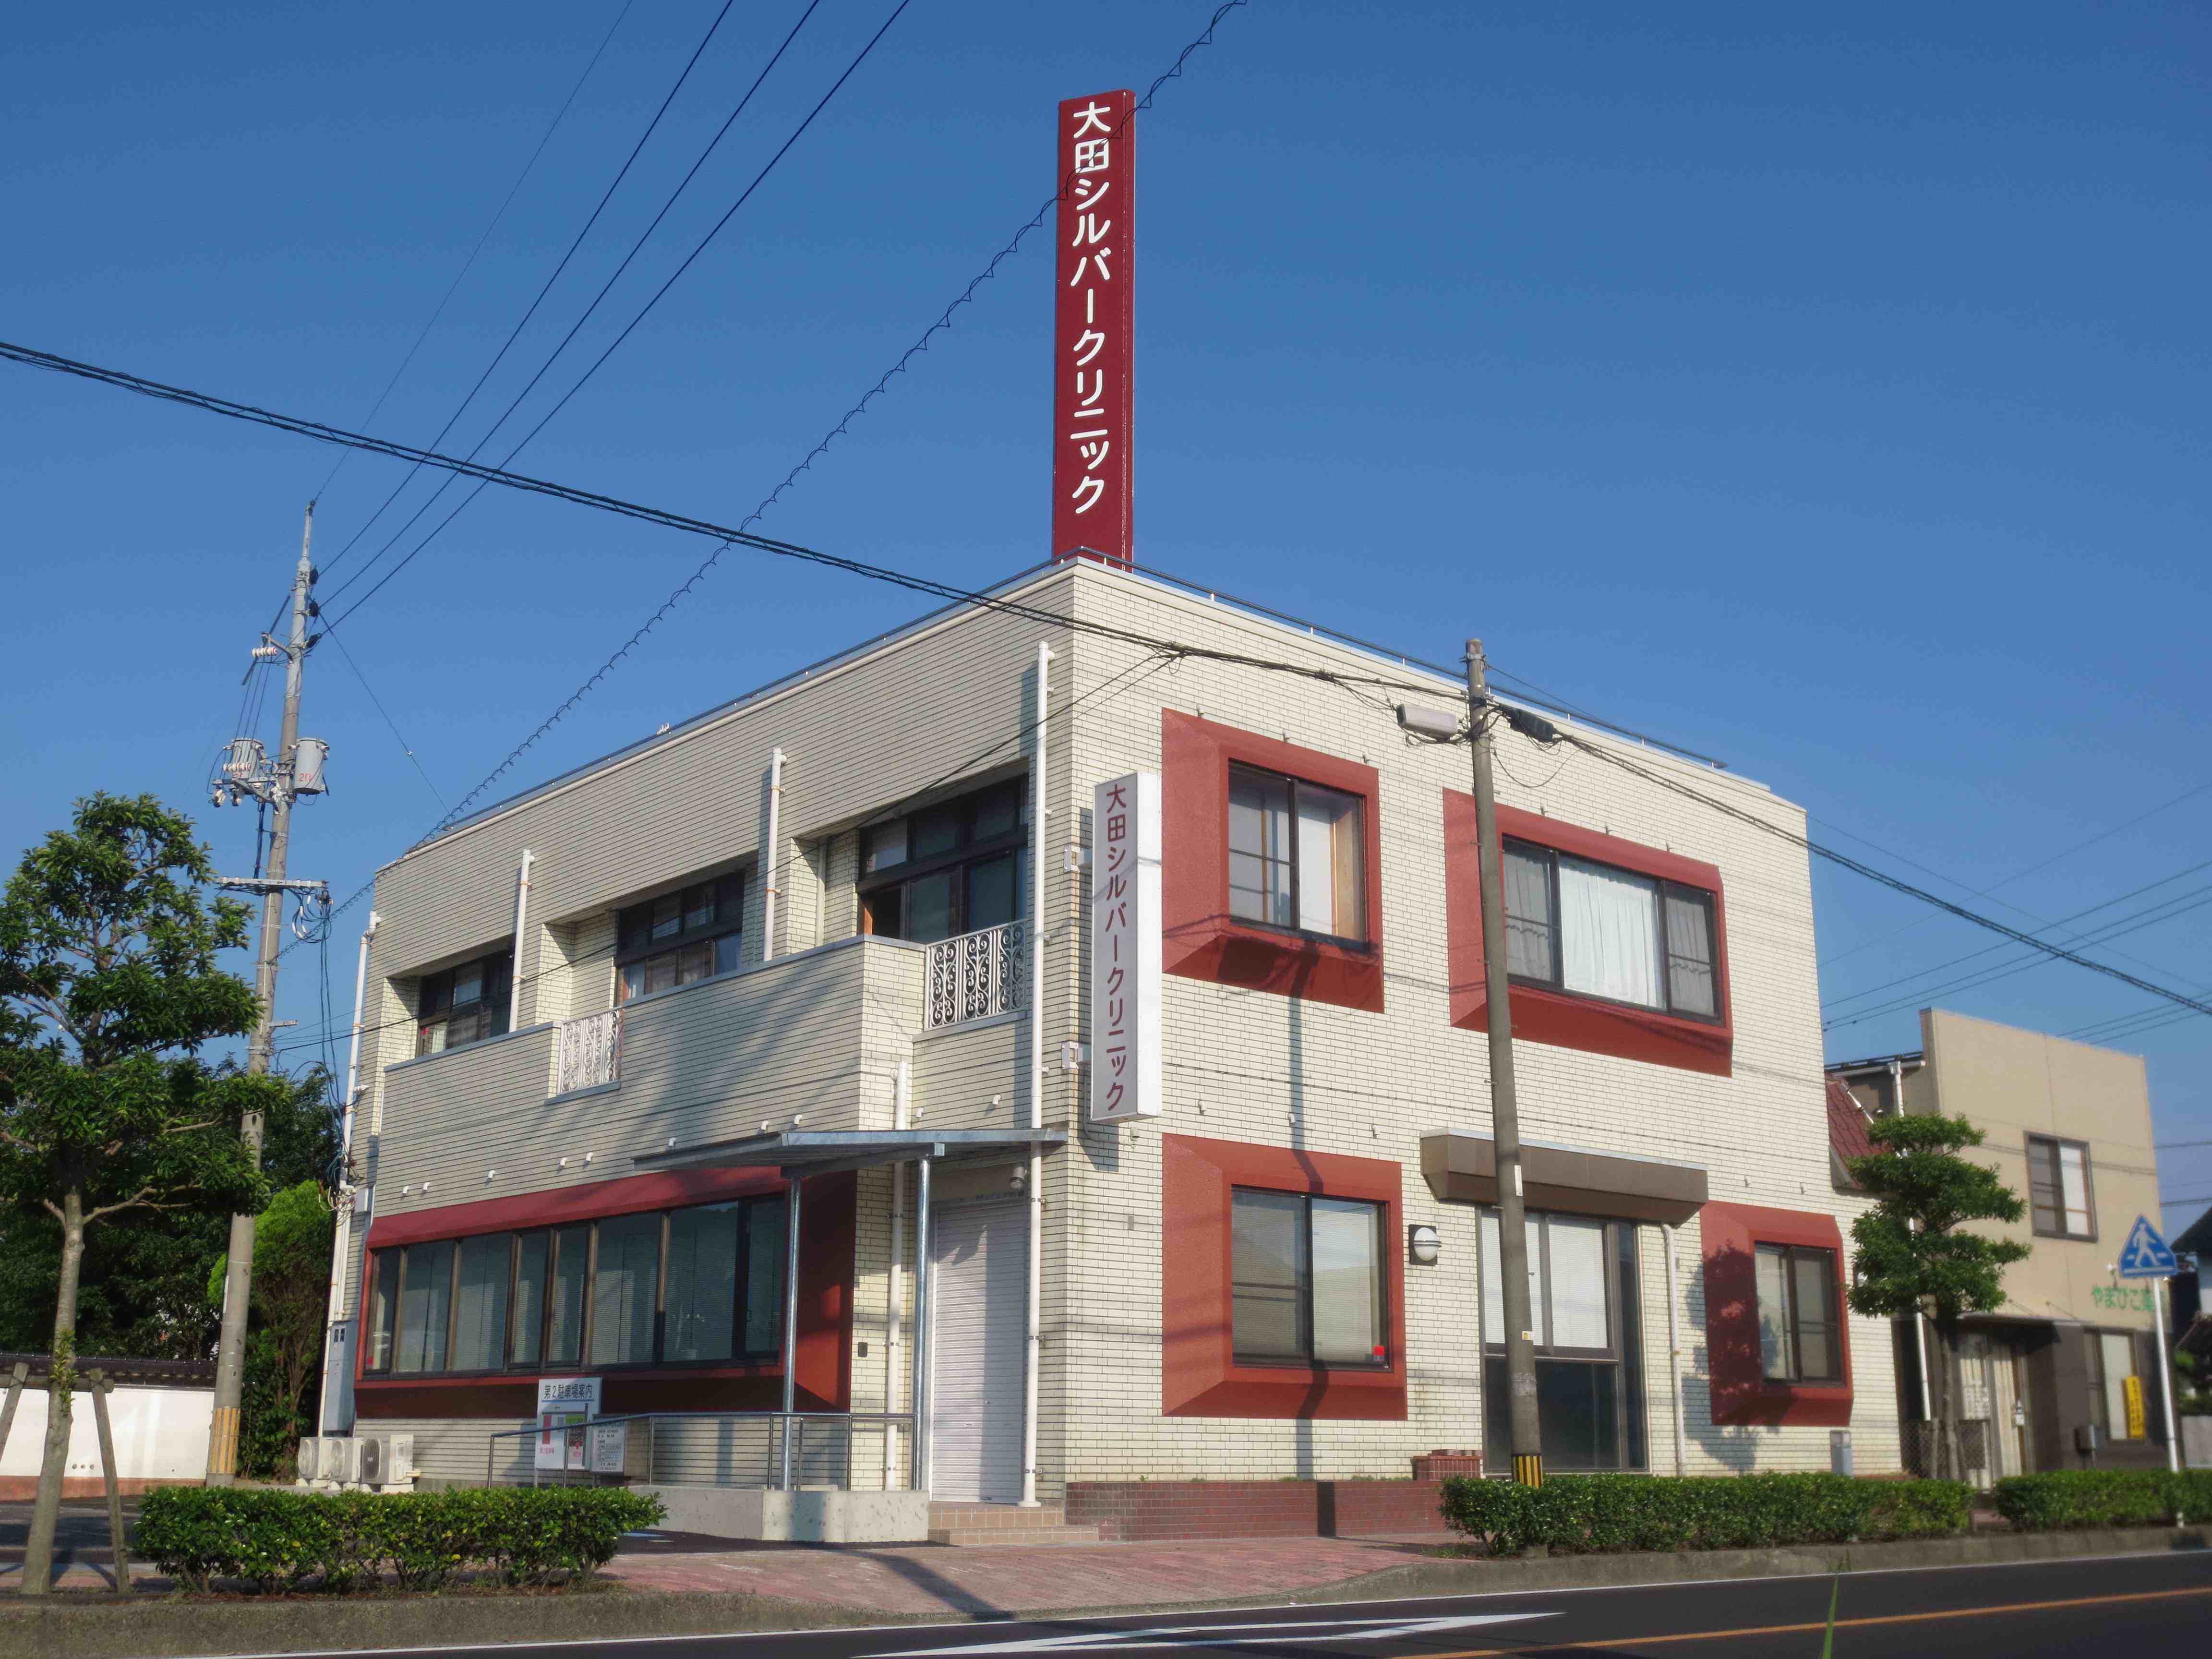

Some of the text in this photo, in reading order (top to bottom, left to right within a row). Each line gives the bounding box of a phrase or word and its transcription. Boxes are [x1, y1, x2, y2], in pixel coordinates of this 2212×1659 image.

[1070, 101, 1112, 514] 大田シルバークリニック
[1105, 783, 1127, 1111] 大田シルバークリニック
[544, 1383, 593, 1399] 第2駐車場案内
